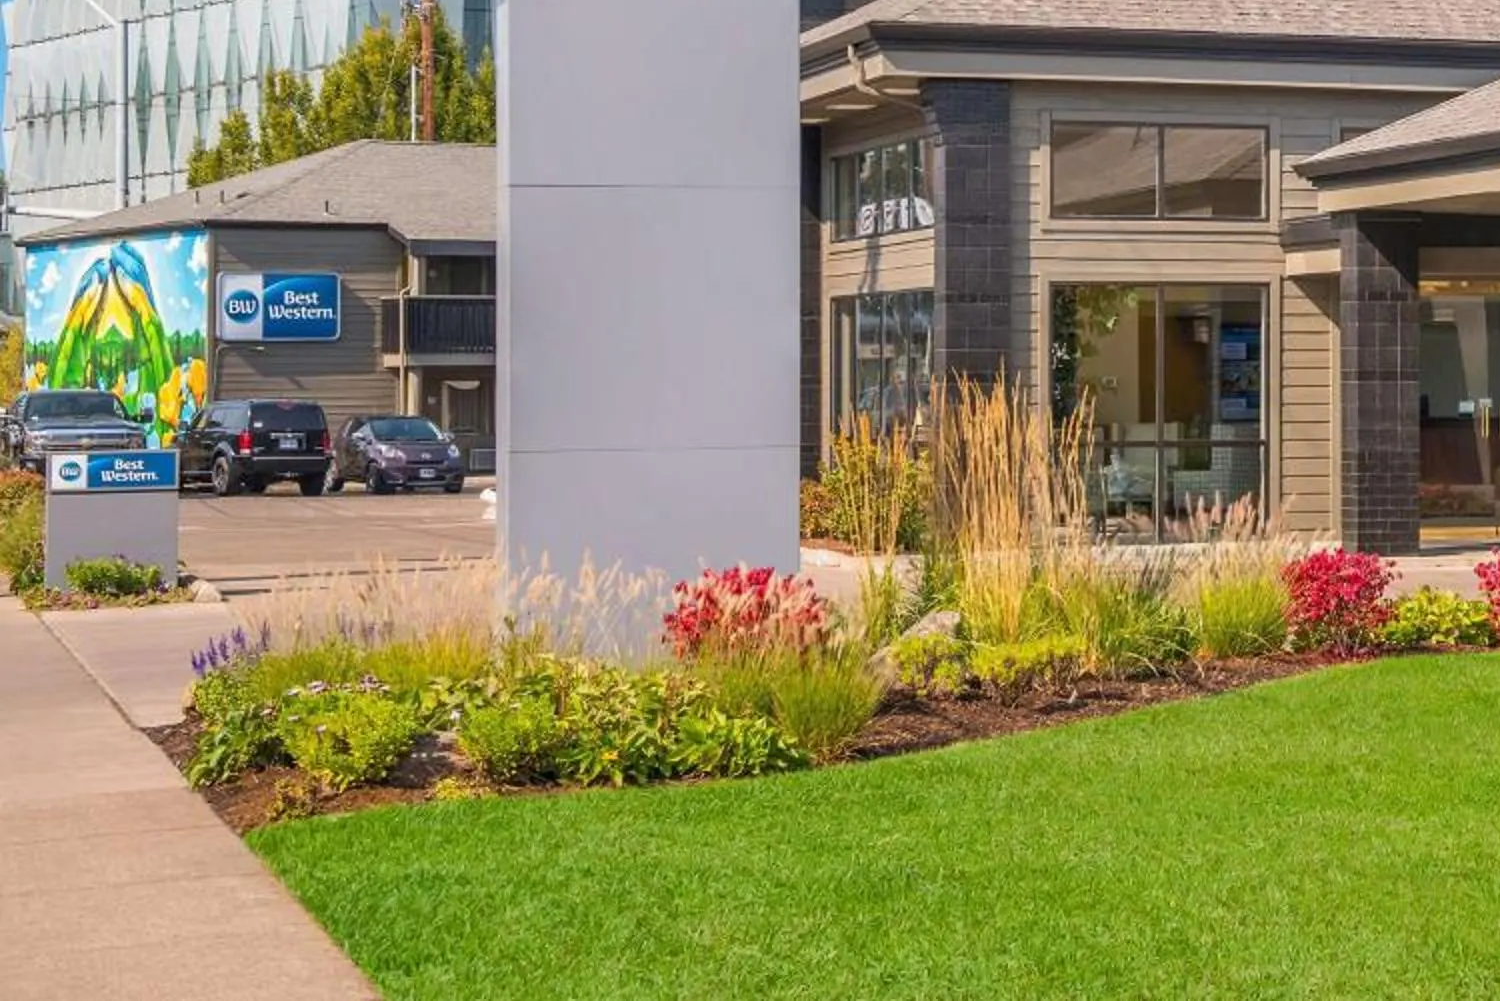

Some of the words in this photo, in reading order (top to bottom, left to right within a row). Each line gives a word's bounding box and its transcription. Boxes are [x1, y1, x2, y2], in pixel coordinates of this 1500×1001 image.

[284, 290, 319, 304] Best
[229, 300, 256, 314] BW
[114, 459, 144, 470] Best
